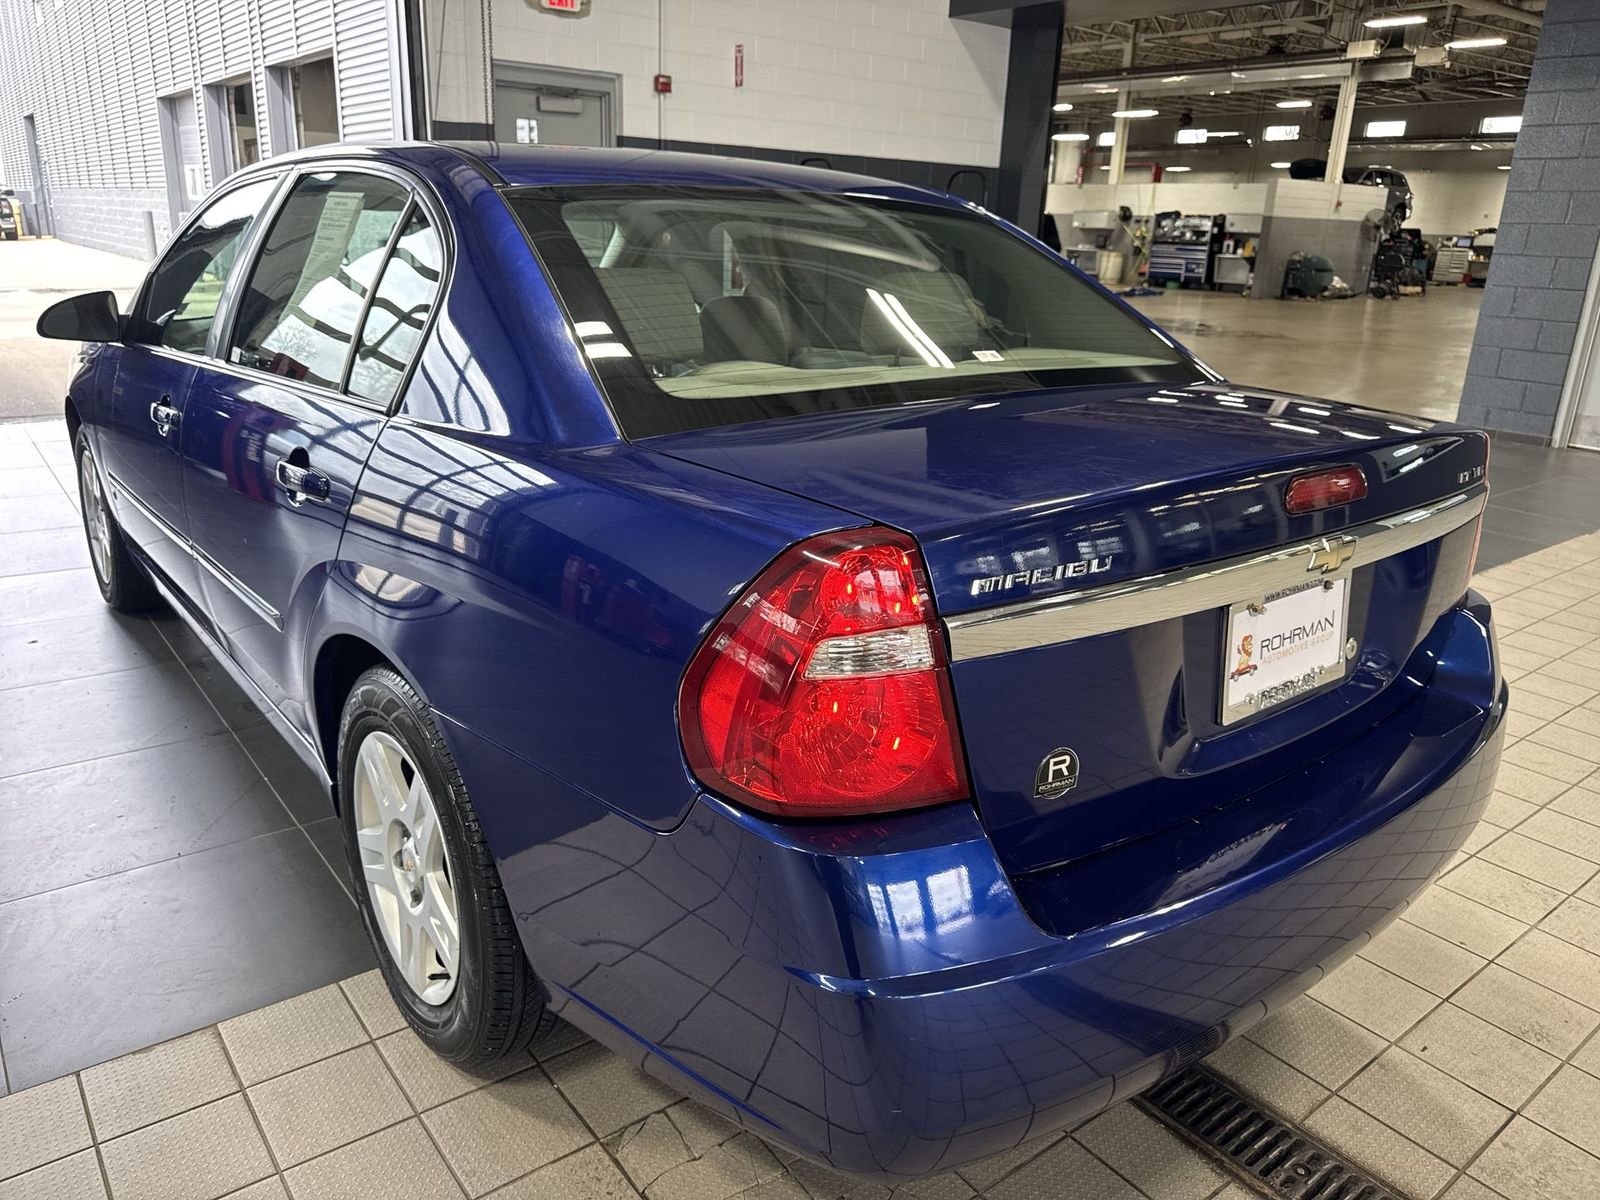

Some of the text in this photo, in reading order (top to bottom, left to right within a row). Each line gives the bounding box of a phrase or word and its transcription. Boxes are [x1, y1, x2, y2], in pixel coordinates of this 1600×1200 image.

[971, 556, 1112, 596] MALIBU
[1260, 609, 1335, 660] ROHRMAN
[1262, 630, 1335, 664] AUTOMOTIVE GROUP
[1038, 777, 1075, 792] ROHRMAN
[1048, 755, 1071, 783] R
